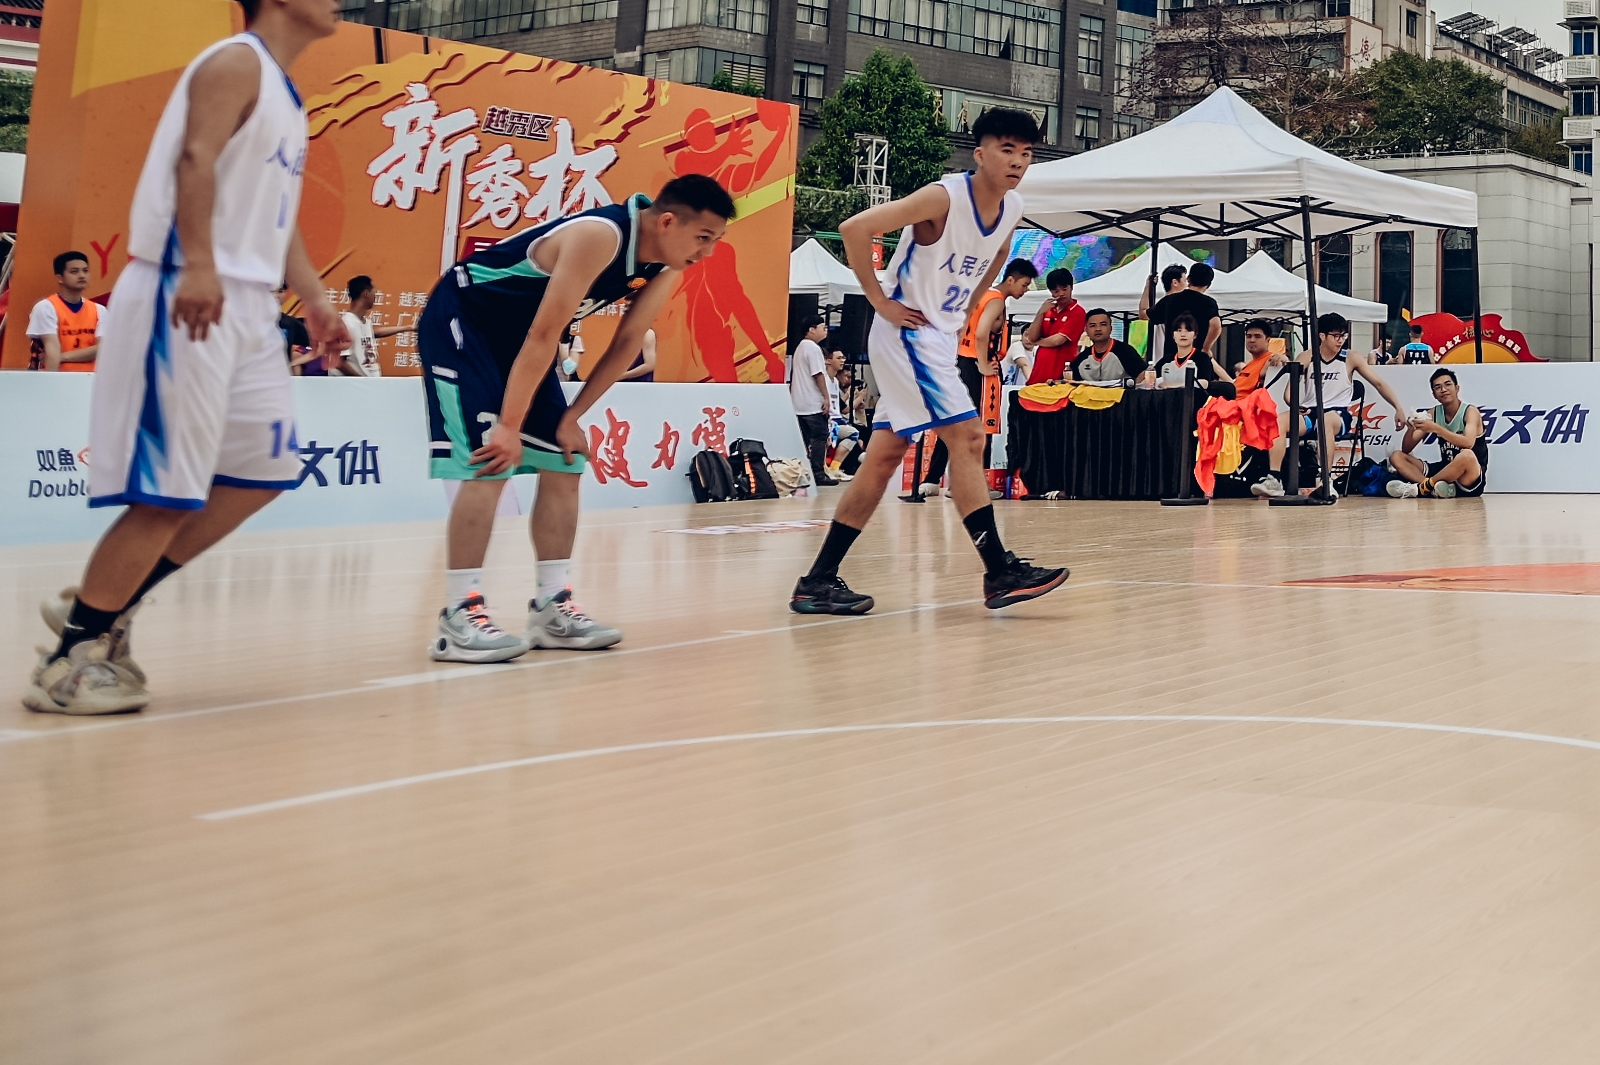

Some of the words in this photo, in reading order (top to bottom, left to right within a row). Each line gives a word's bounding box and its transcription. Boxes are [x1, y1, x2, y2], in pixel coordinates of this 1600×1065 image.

[481, 106, 555, 140] 越秀区
[366, 82, 619, 276] 新秀杯
[940, 285, 970, 313] 22
[28, 479, 90, 499] Doubl
